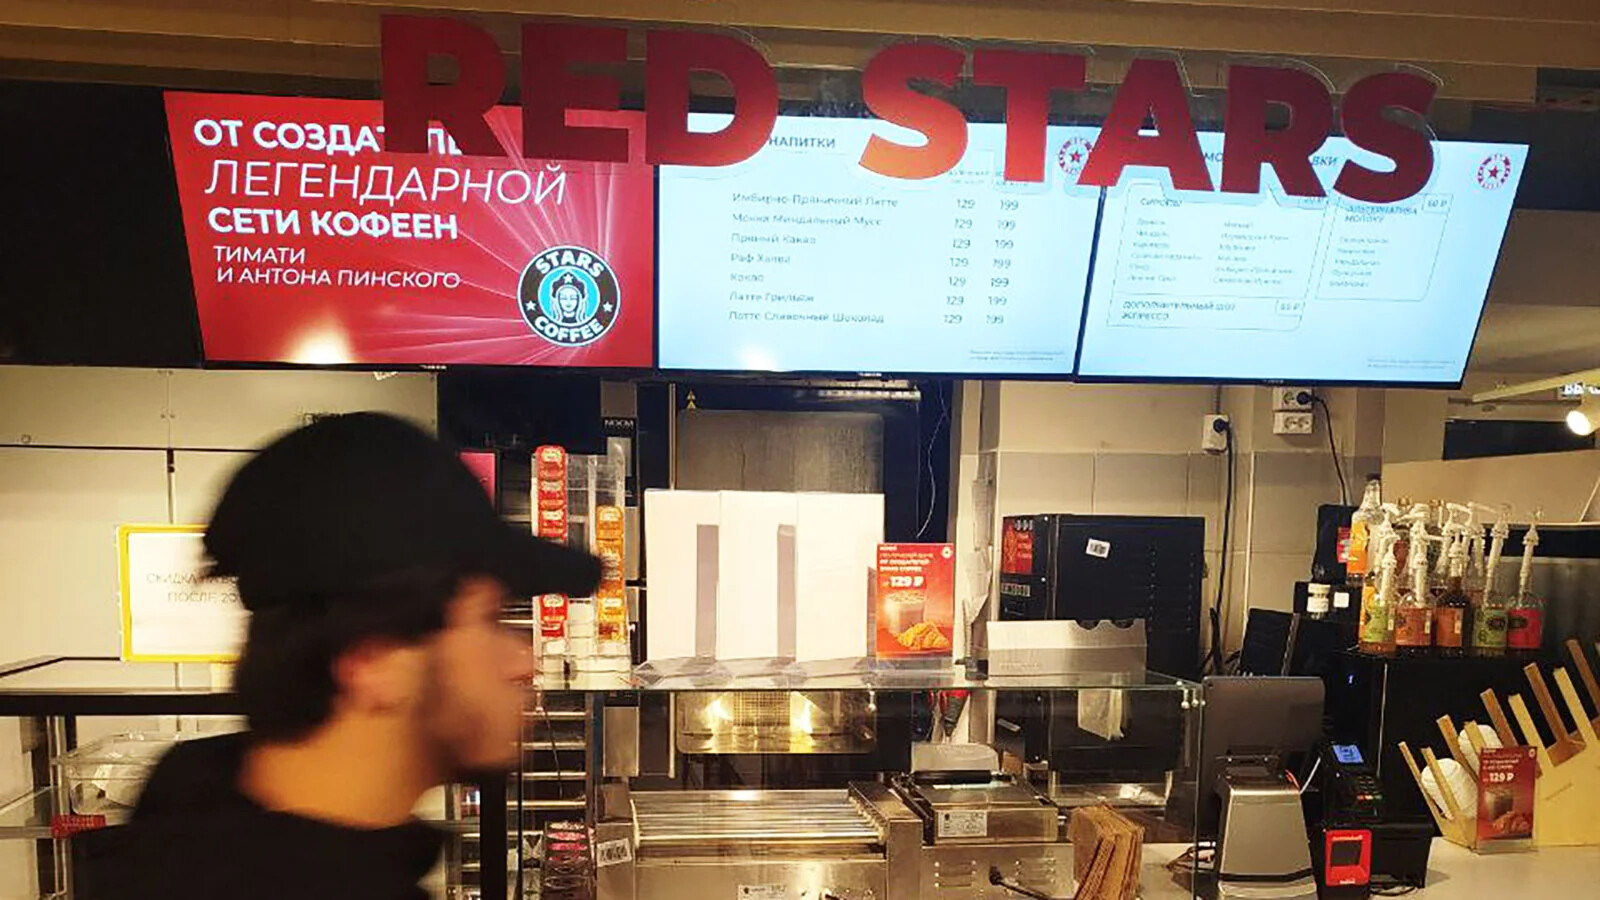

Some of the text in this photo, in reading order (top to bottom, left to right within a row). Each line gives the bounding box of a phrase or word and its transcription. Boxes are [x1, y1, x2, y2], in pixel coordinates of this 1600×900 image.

[380, 14, 1438, 203] RED STARS
[194, 119, 243, 149] ОТ
[768, 136, 836, 149] НАПИТКИ
[204, 160, 567, 206] ЛЕГЕНДАРНОЙ
[957, 199, 975, 209] 129
[1000, 199, 1019, 210] 199
[208, 207, 459, 240] СЕТИ КОФЕЕН
[954, 219, 973, 229] 129
[953, 239, 971, 249] 129
[213, 246, 306, 265] ТИМАТИ
[535, 250, 605, 278] STARS
[950, 257, 968, 267] 129
[216, 269, 460, 289] И АНТОНА ПИНСКОГО
[949, 276, 966, 287] 129
[946, 296, 964, 305] 129
[944, 314, 962, 324] 129
[534, 316, 604, 342] COFFEE
[890, 575, 912, 587] 129
[1490, 772, 1505, 782] 129
